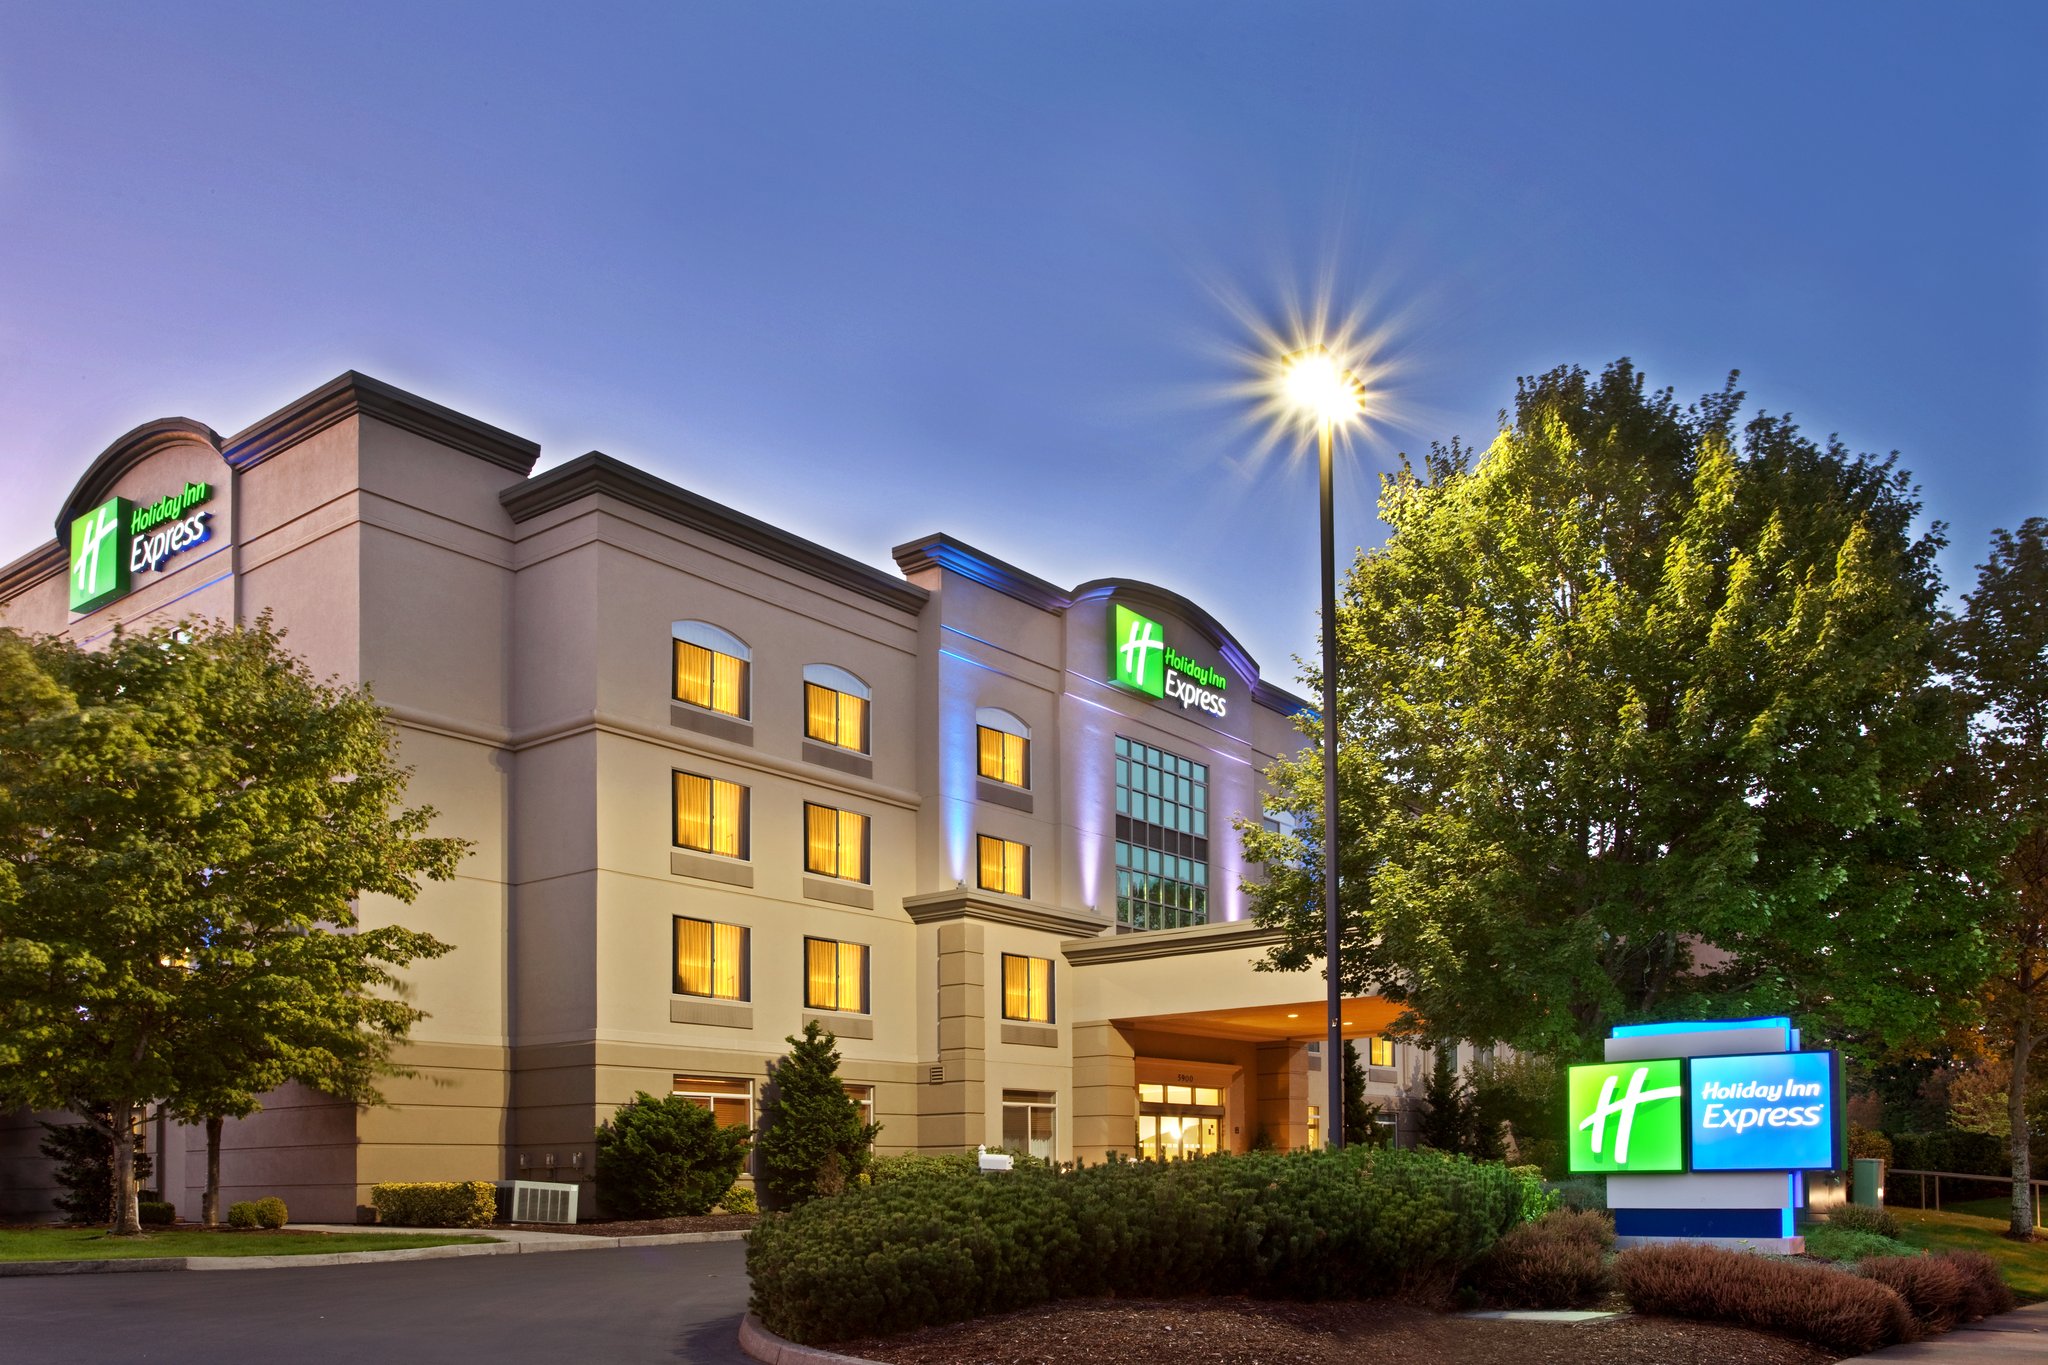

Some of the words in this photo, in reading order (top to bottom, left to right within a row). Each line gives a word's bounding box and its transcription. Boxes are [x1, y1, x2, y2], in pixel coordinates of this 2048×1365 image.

[131, 495, 183, 535] Holiday
[183, 482, 207, 508] Inn
[130, 511, 206, 572] Express
[1165, 646, 1208, 686] Holiday
[1209, 666, 1227, 690] Inn
[1165, 669, 1227, 717] Express
[1177, 1074, 1194, 1083] 5900
[1701, 1080, 1782, 1102] Holiday
[1785, 1078, 1821, 1097] Inn
[1702, 1103, 1823, 1134] Express
